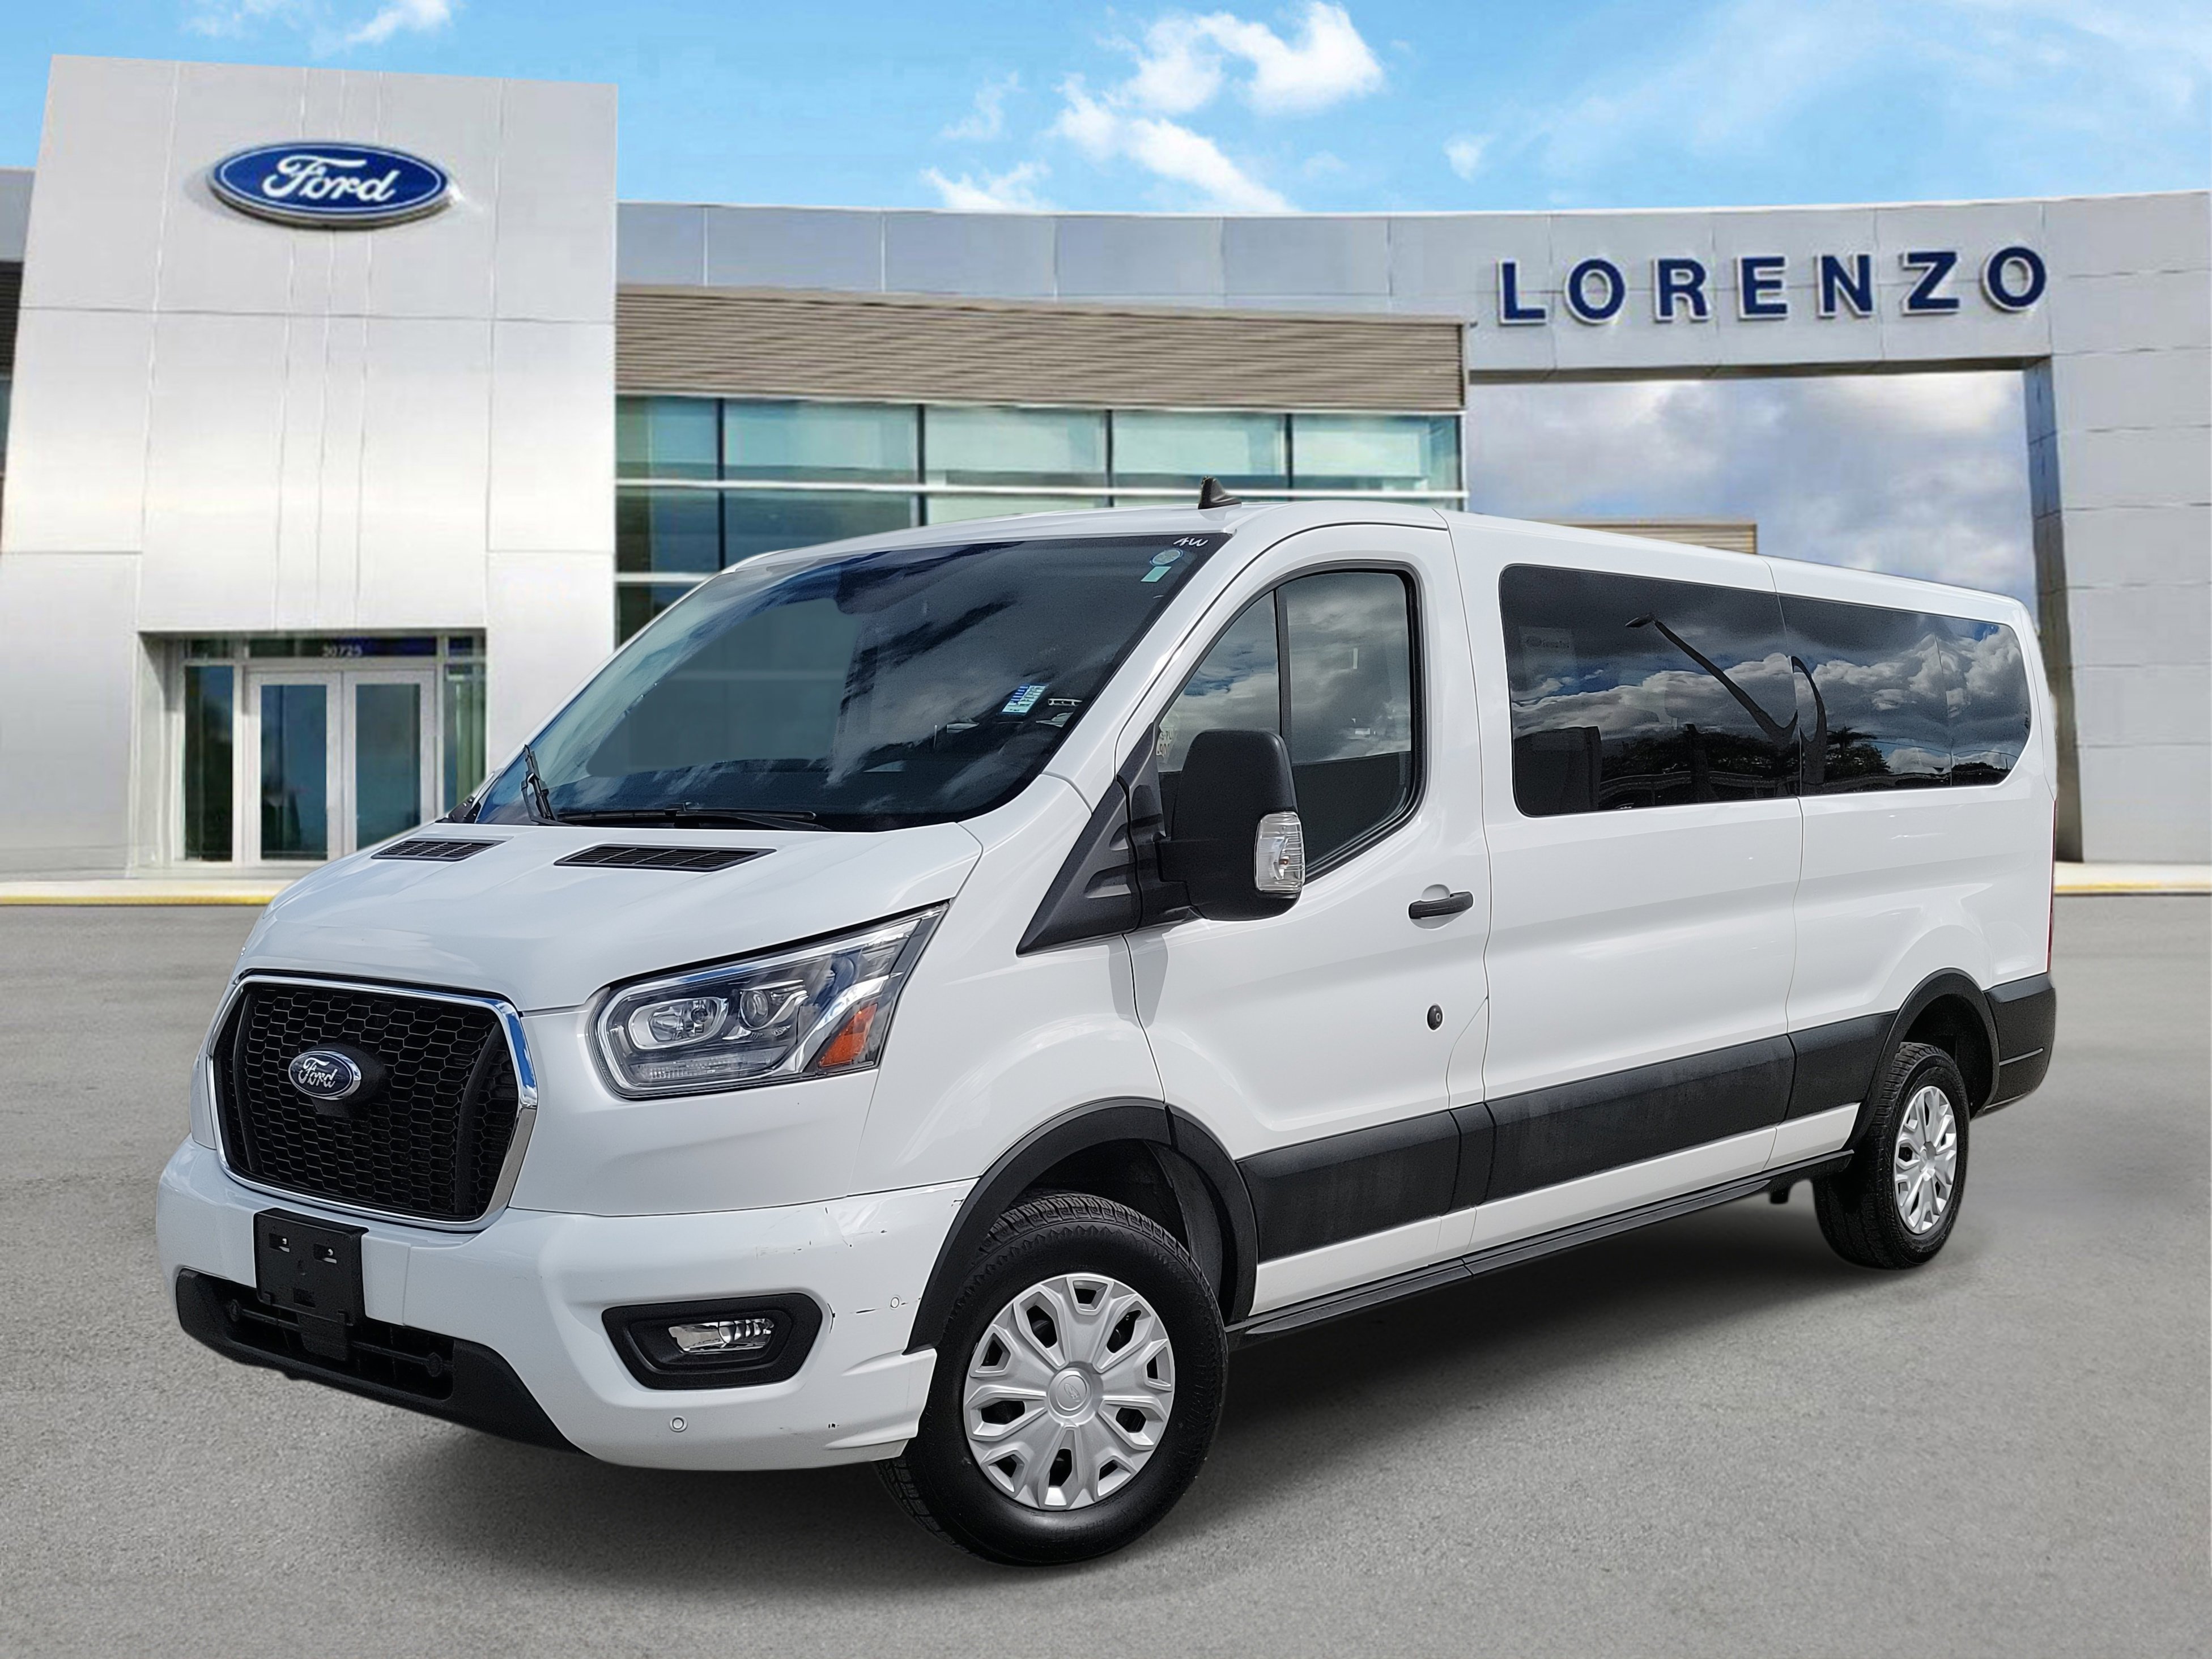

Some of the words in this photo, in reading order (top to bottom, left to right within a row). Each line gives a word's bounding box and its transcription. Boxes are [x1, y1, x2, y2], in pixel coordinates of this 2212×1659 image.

[262, 154, 401, 202] Ford
[1499, 246, 2047, 325] LORENZO
[298, 1057, 338, 1088] Ford
